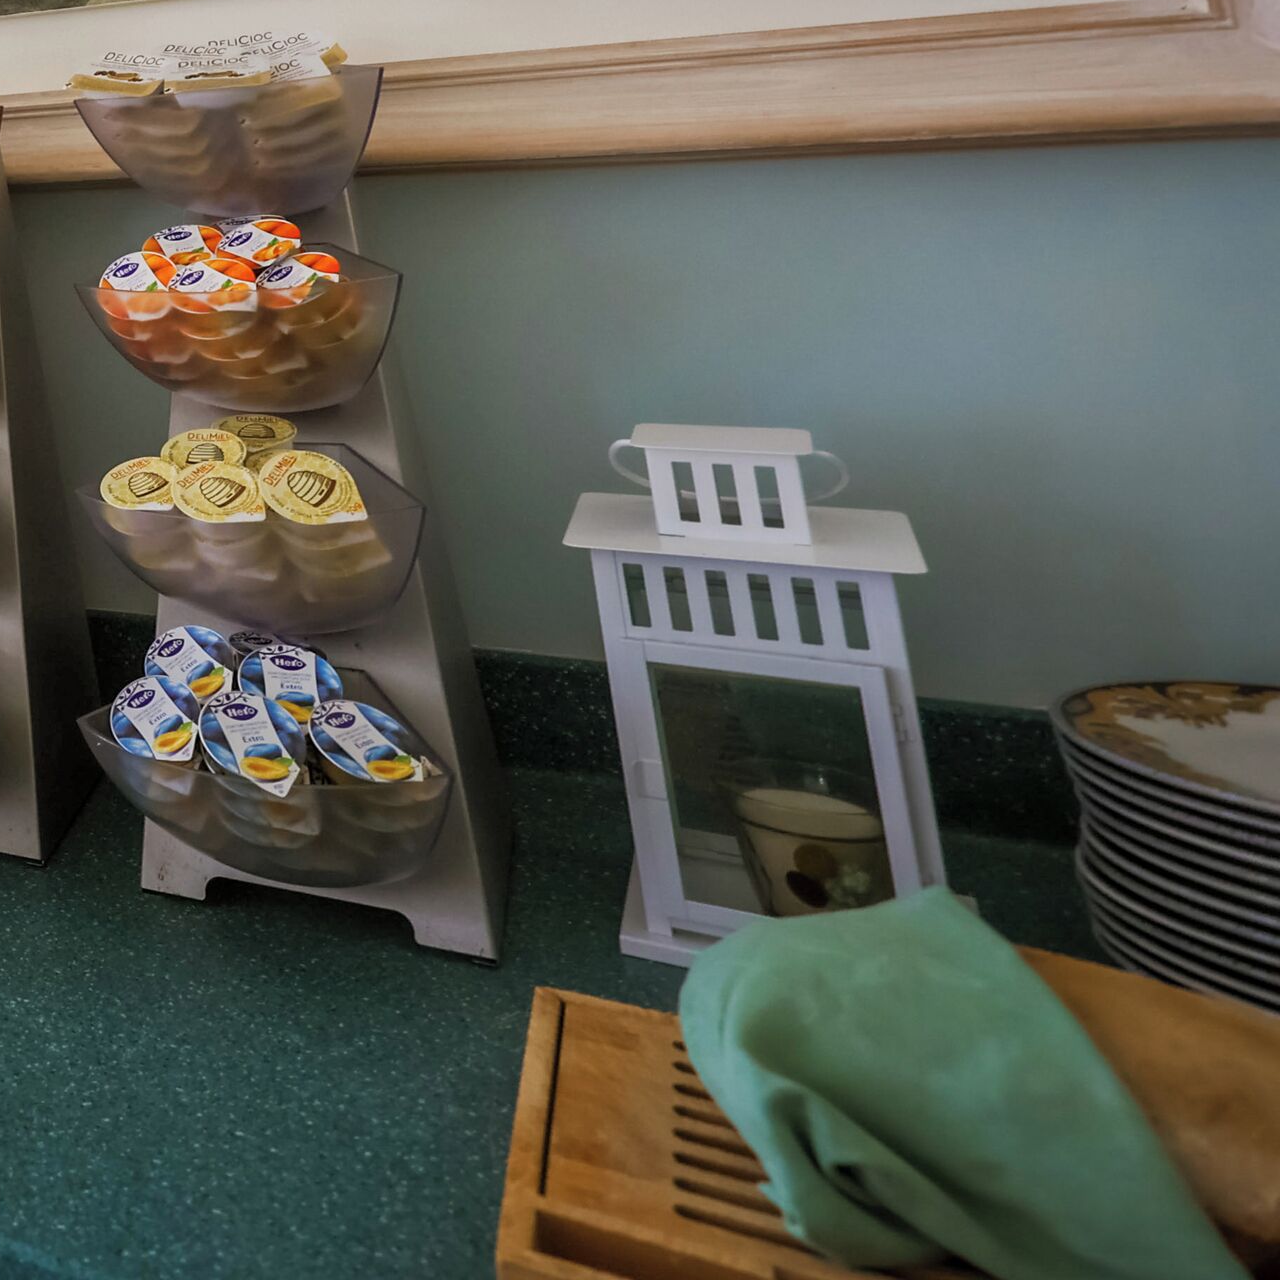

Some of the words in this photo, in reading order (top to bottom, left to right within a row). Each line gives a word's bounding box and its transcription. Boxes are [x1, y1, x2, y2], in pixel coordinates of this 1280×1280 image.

[103, 51, 166, 67] DELICIOC
[177, 55, 249, 69] DELICIOC
[187, 431, 231, 442] DELIMIEL
[263, 455, 297, 486] DELIMIEL
[159, 640, 182, 656] Hero
[272, 656, 303, 670] Hero
[128, 691, 153, 707] Hero
[226, 704, 255, 720] Hero
[327, 712, 353, 728] Hero
